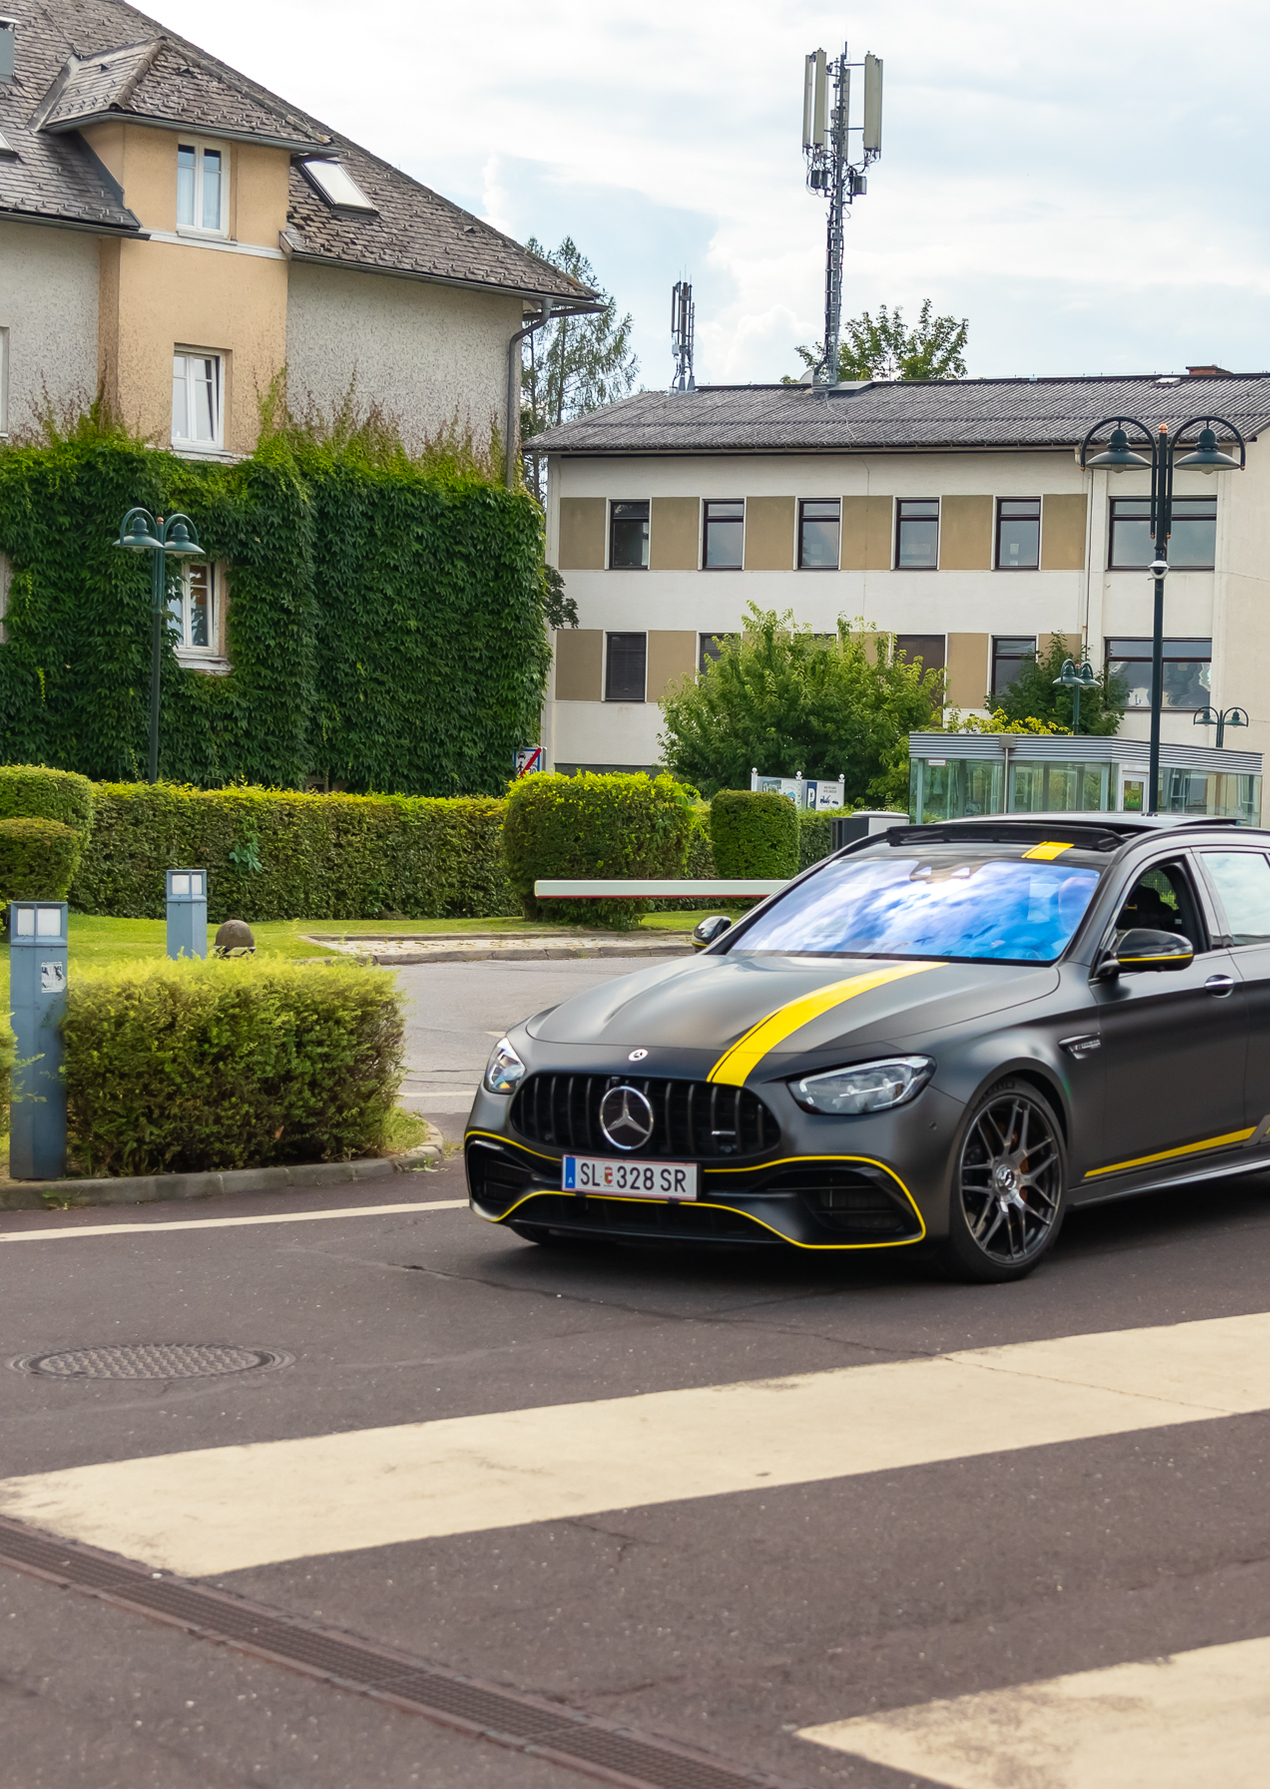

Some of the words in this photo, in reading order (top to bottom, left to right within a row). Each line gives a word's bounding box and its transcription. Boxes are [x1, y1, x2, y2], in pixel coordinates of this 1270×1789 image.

[567, 1176, 573, 1184] A
[580, 1162, 601, 1187] SL
[616, 1165, 655, 1191] 328
[660, 1168, 686, 1193] SR
